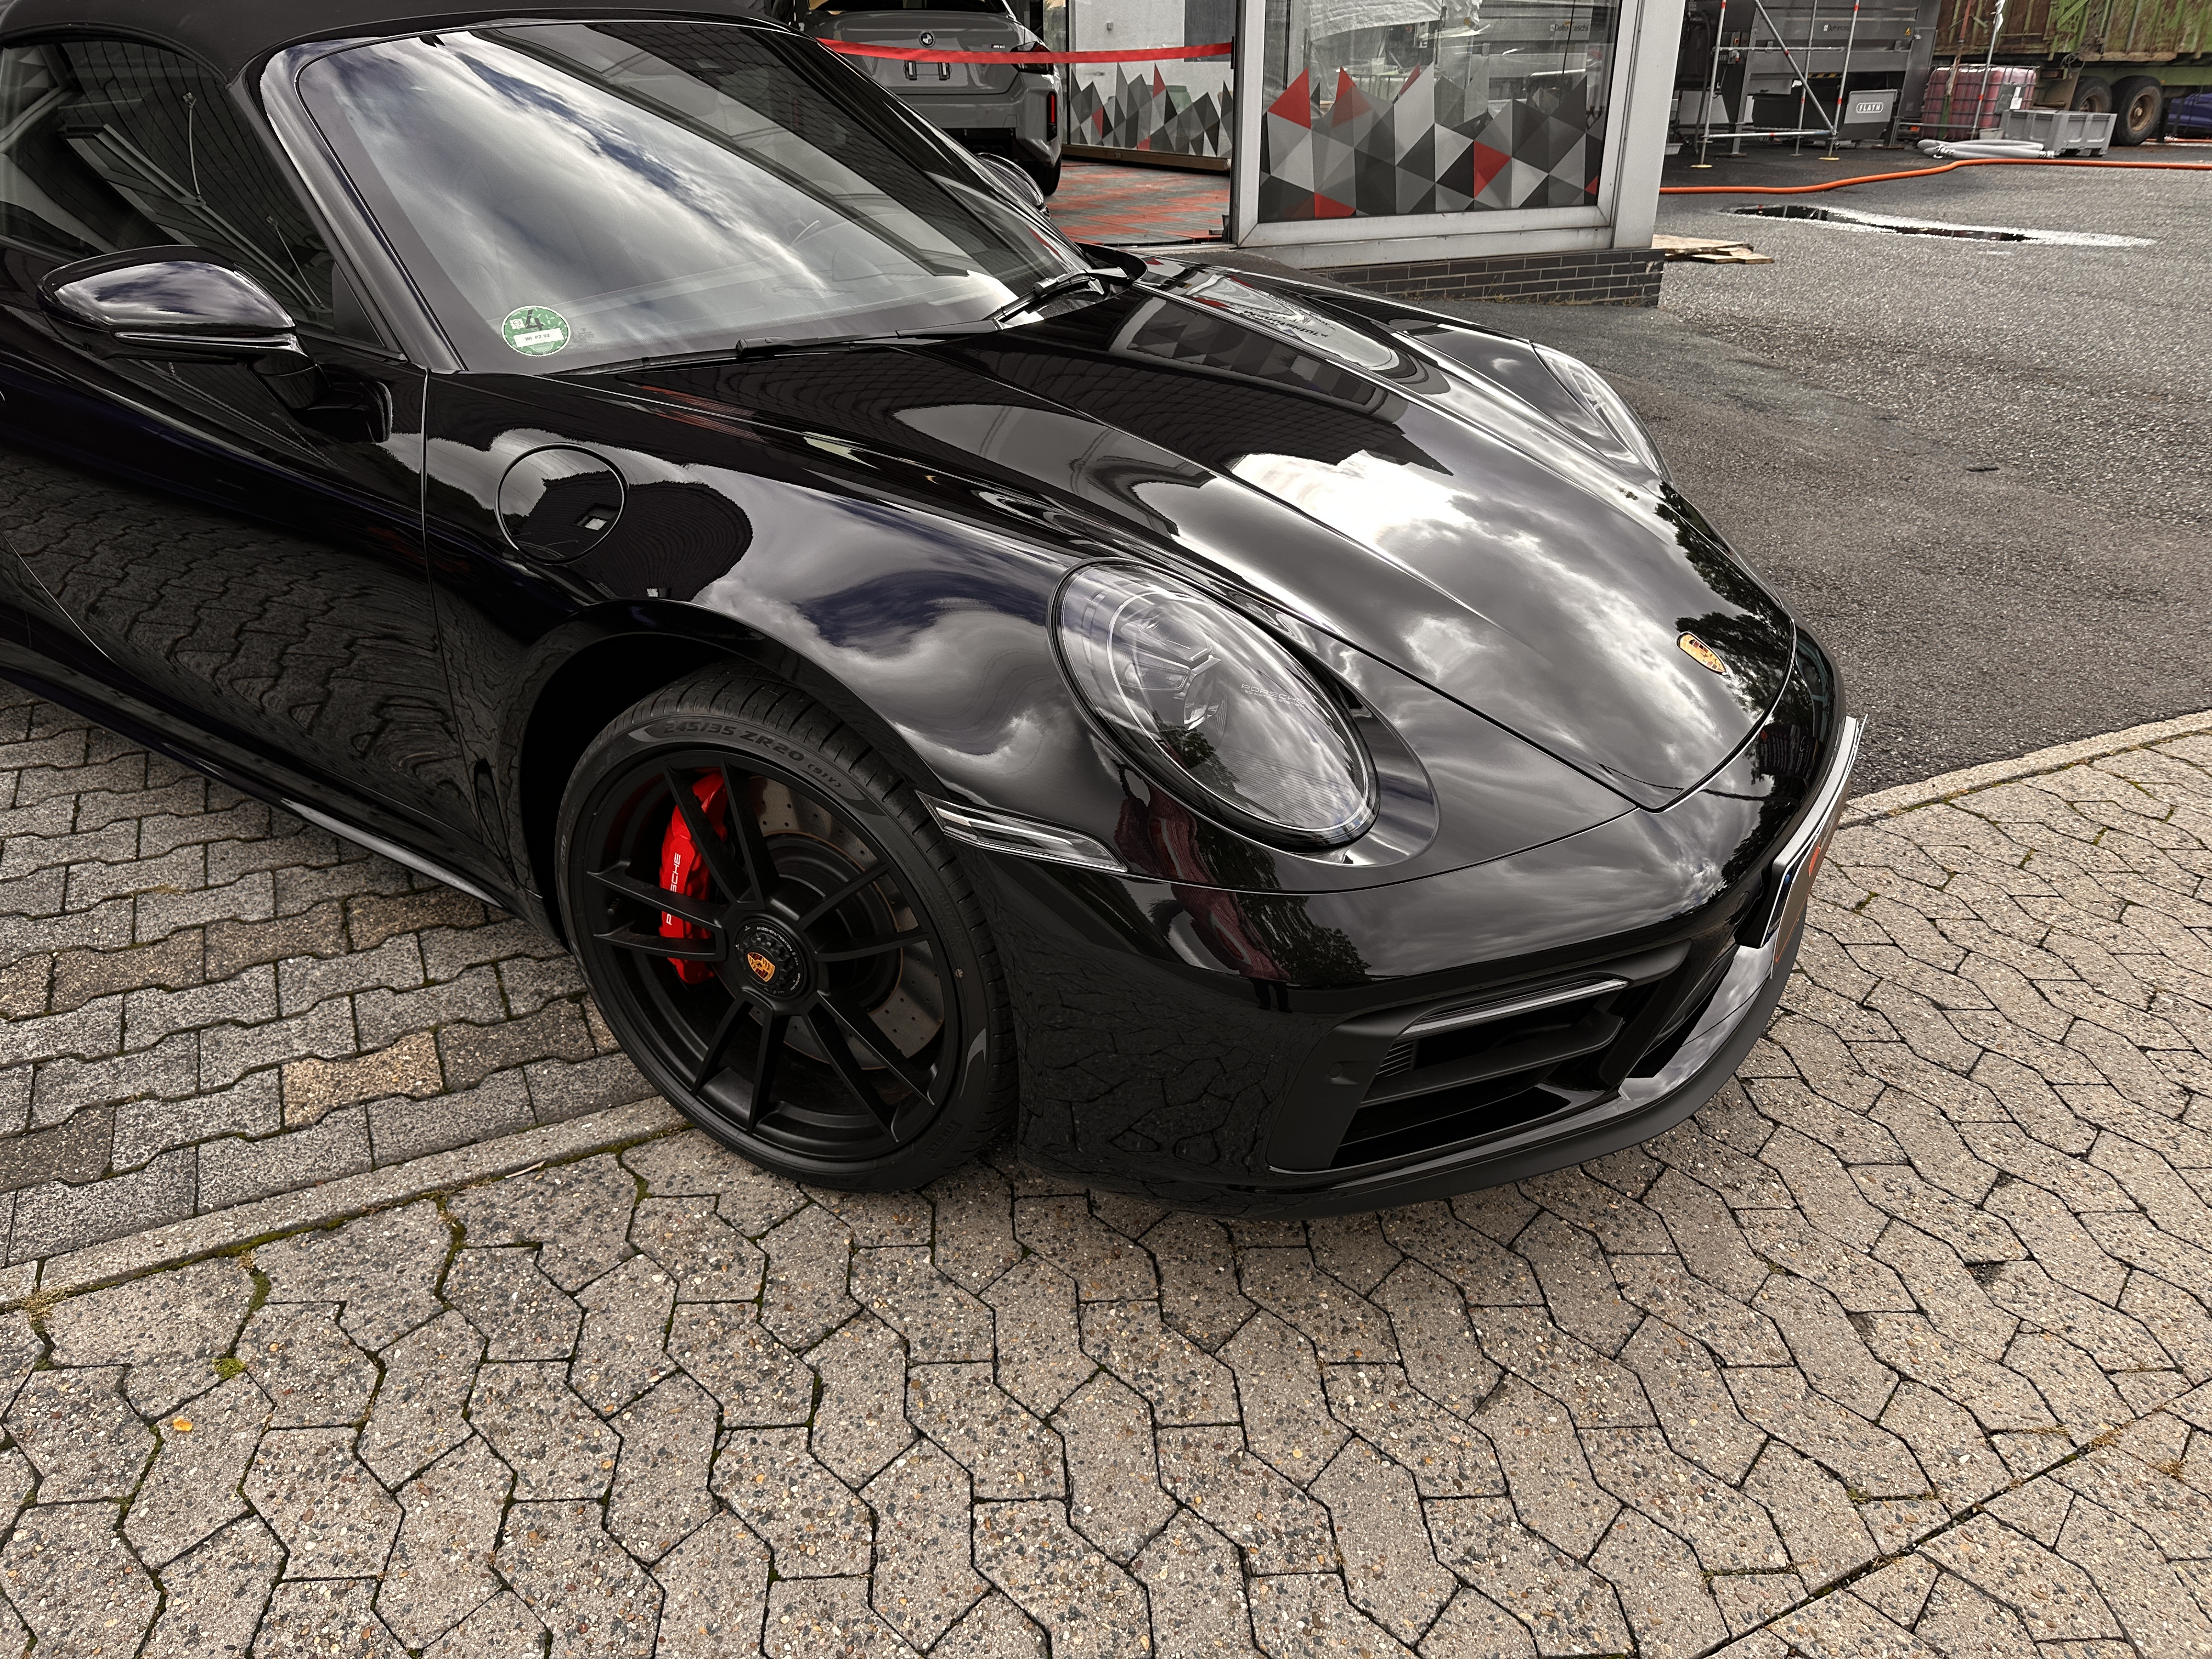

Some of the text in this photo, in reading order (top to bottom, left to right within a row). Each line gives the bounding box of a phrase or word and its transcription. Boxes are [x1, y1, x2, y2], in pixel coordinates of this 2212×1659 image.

[526, 309, 544, 330] 4
[1241, 684, 1306, 704] PORSCHE
[663, 721, 734, 737] 245/35
[738, 730, 805, 761] ZR20
[666, 853, 681, 926] PSCHE
